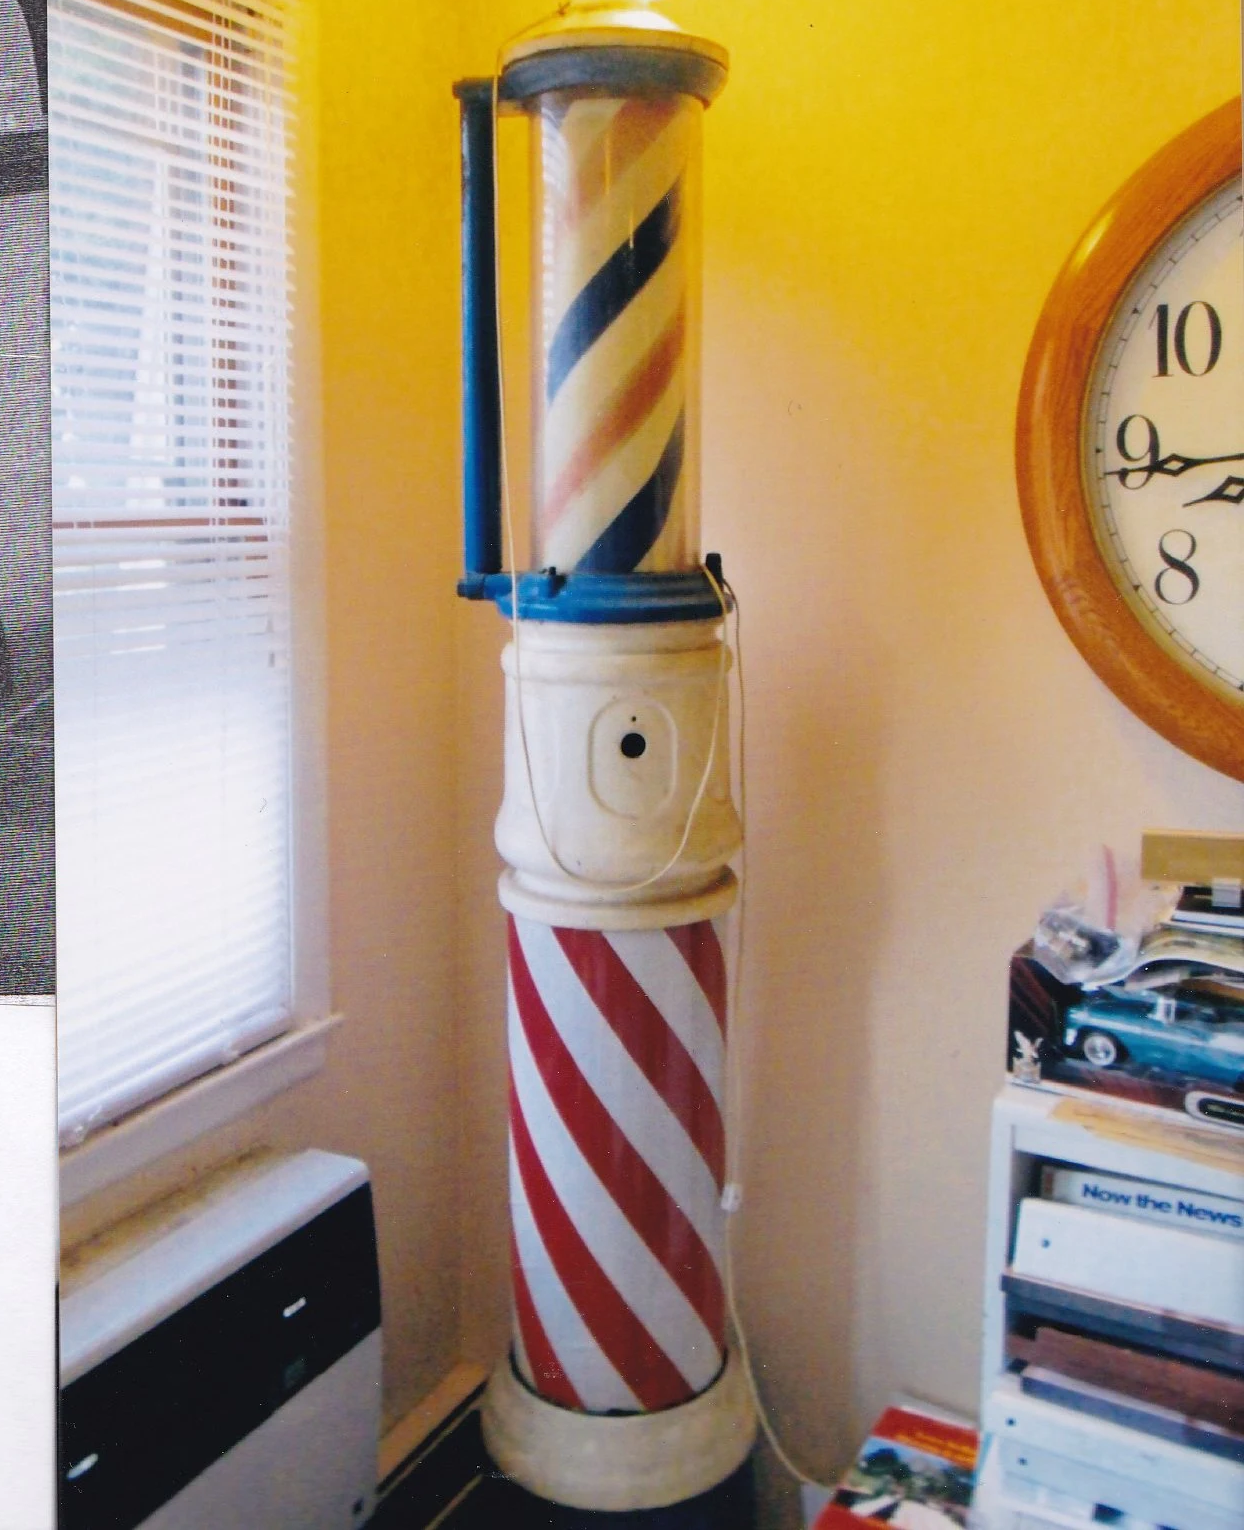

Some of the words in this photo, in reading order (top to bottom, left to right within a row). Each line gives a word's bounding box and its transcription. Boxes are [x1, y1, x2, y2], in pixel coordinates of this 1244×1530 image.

[1149, 300, 1223, 378] 10
[1116, 413, 1160, 490] 9
[1154, 528, 1200, 605] 8
[1082, 1183, 1132, 1206] Now
[1136, 1192, 1172, 1214] the
[1176, 1200, 1243, 1228] News
